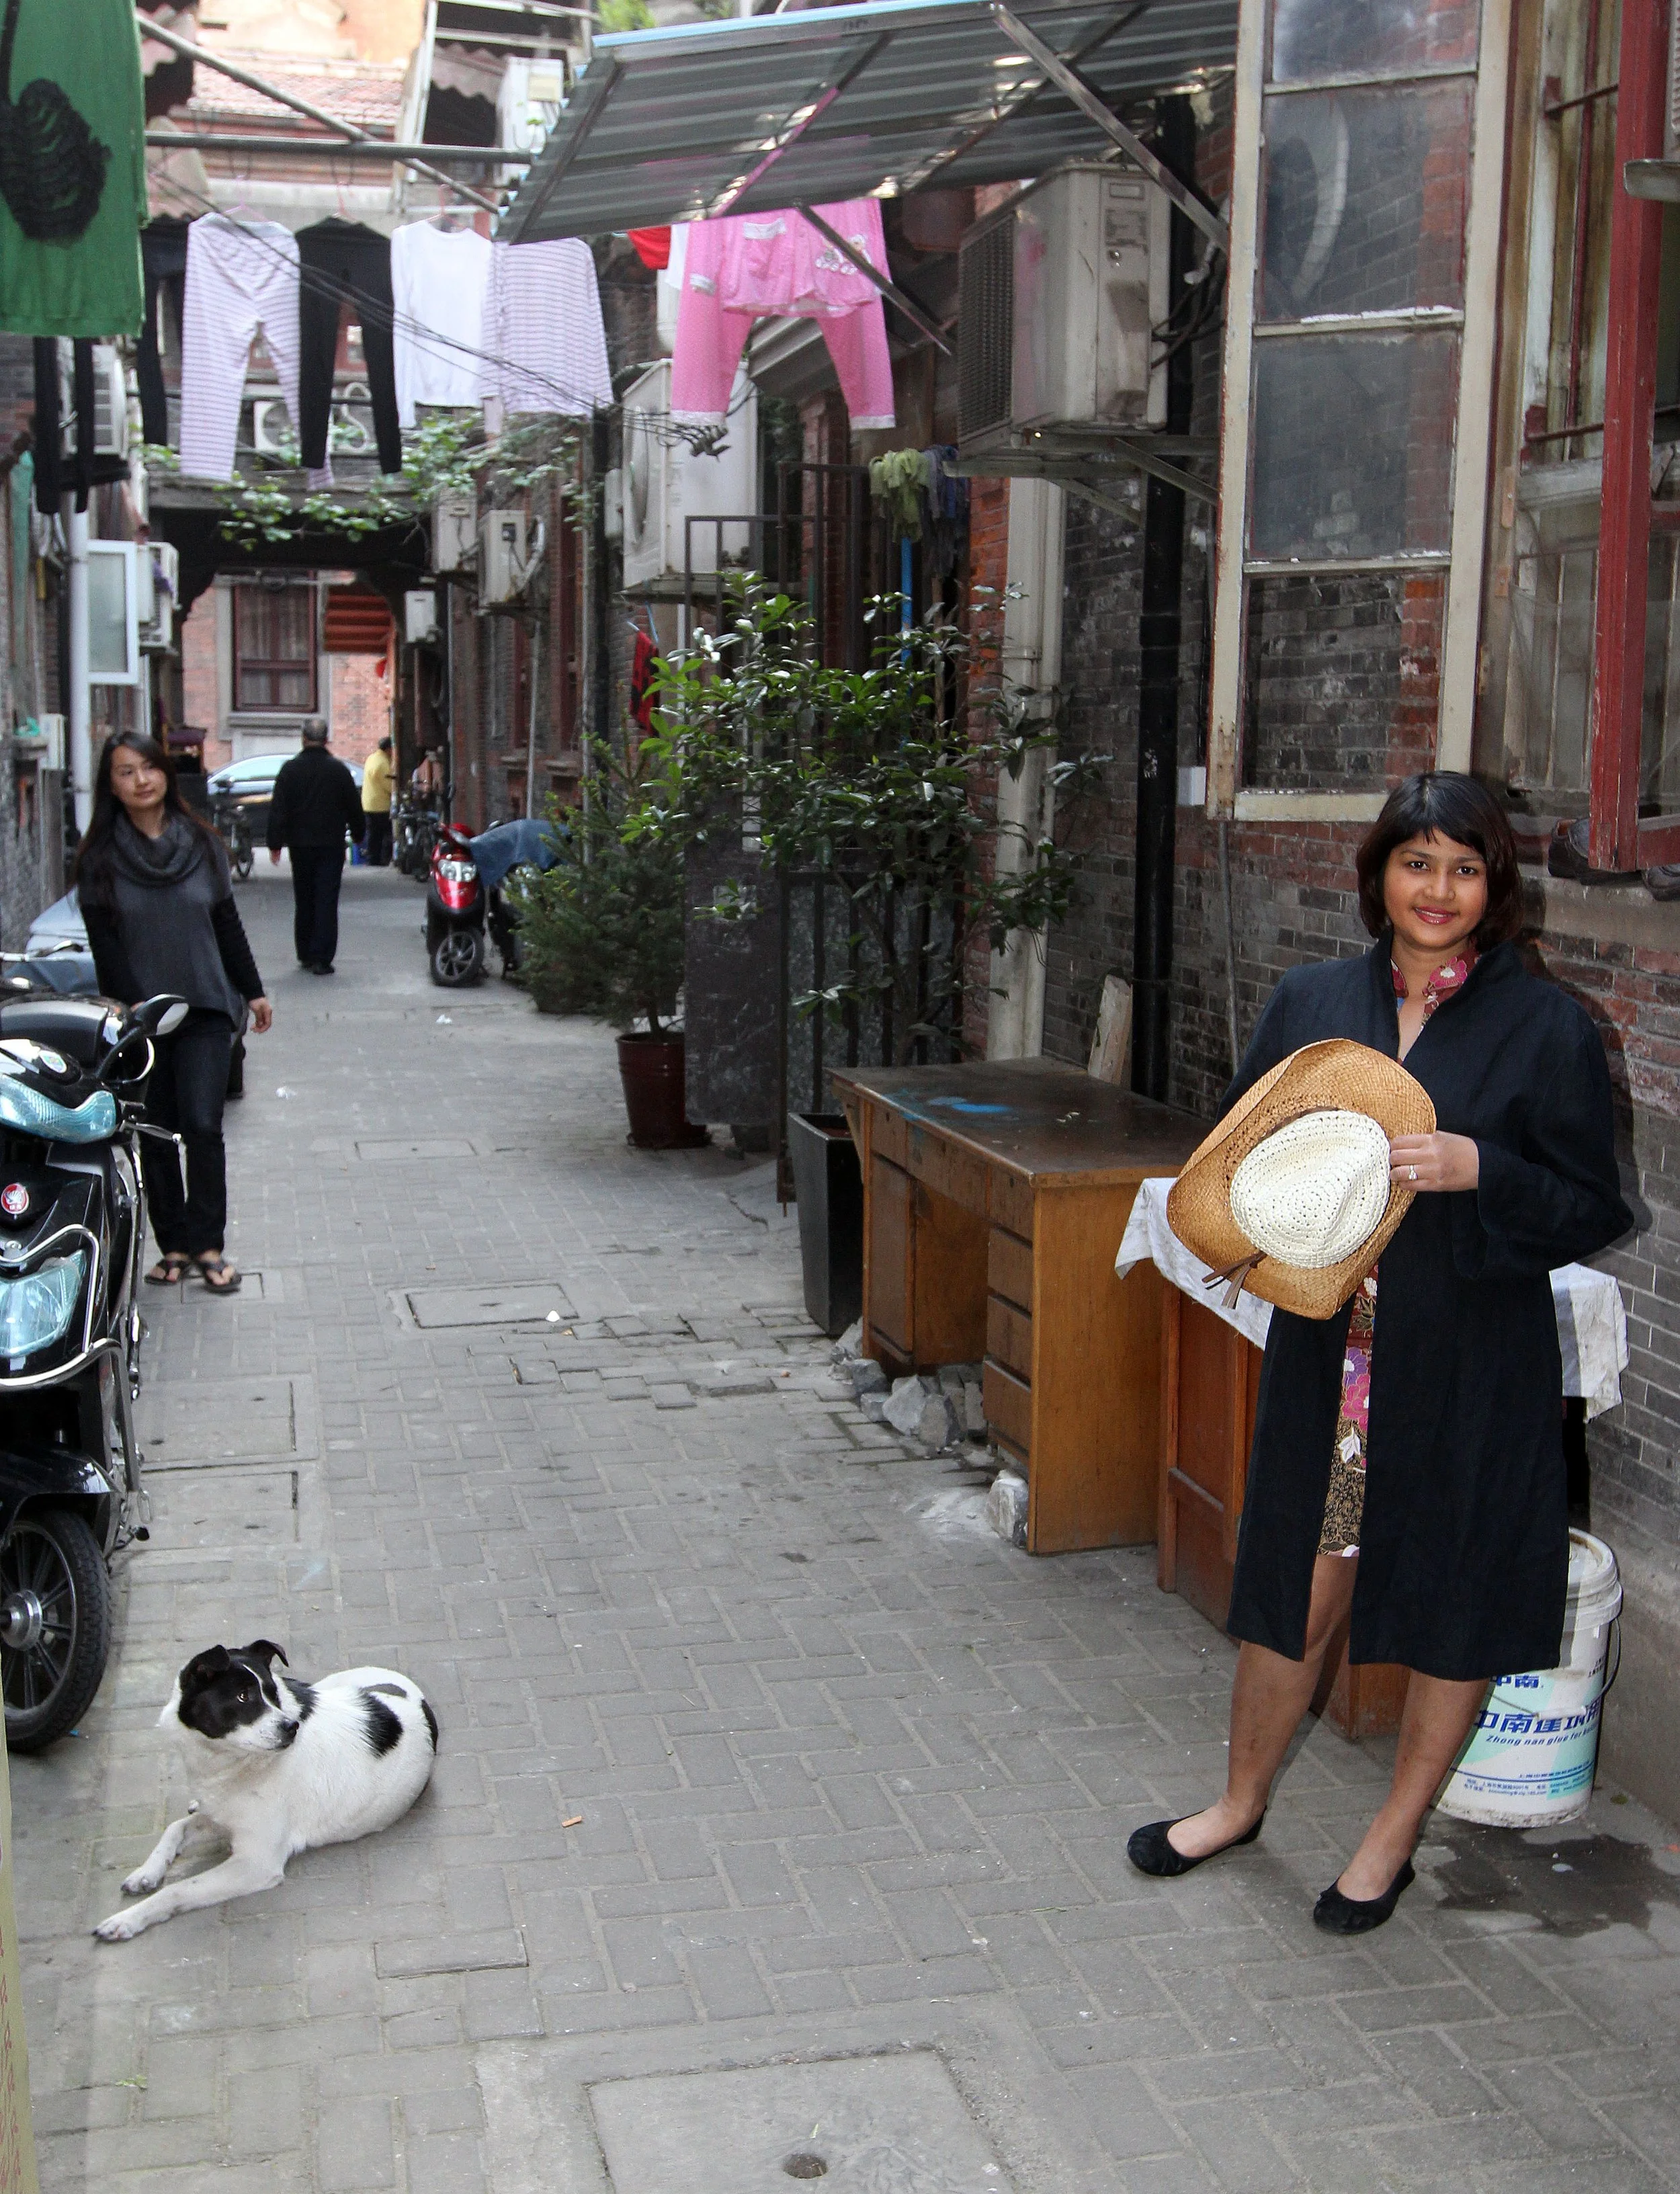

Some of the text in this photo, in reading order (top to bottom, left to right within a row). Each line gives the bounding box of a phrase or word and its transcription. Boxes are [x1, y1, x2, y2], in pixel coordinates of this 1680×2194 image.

[1490, 1675, 1539, 1688] 中南
[1486, 1735, 1521, 1746] Zhong
[1546, 1736, 1568, 1746] glue
